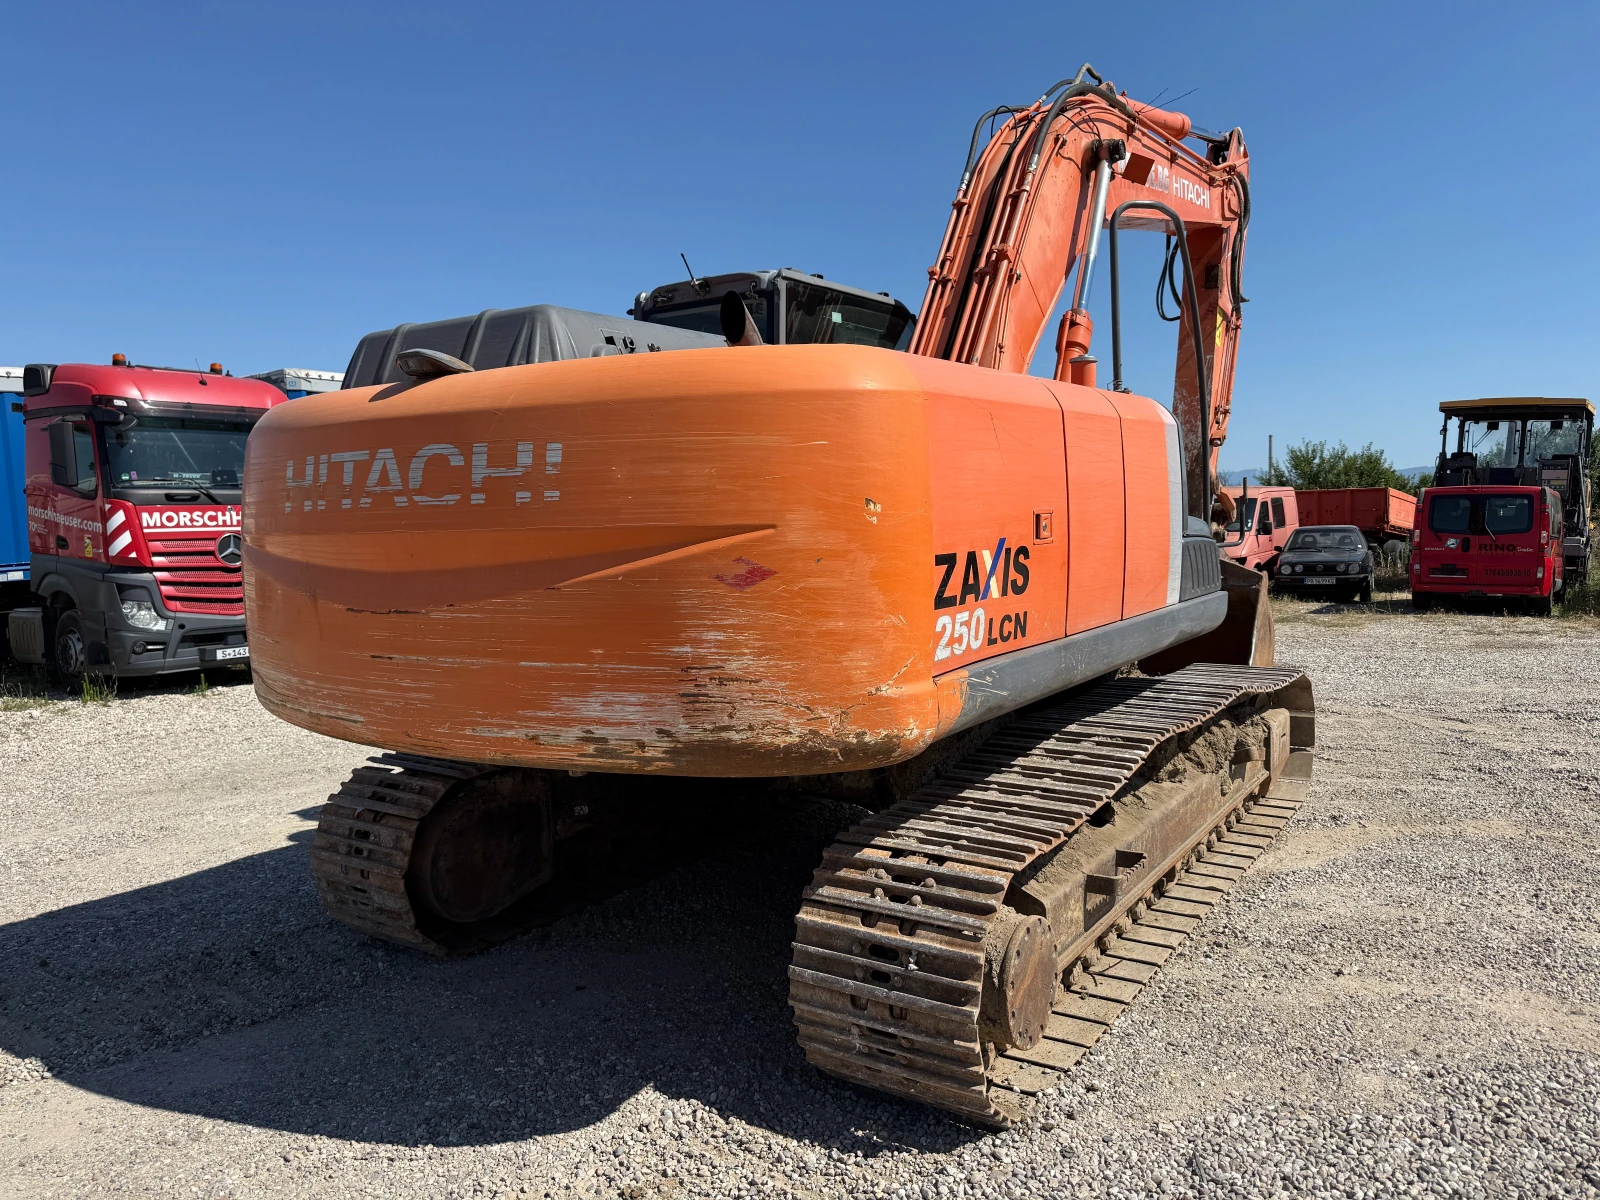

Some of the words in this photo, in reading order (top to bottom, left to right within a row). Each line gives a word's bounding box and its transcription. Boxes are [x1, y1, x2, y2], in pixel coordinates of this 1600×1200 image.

[1173, 175, 1210, 209] HITACHI
[285, 441, 563, 513] HITACHI
[28, 505, 102, 533] morschhaeuser.com
[1479, 543, 1516, 553] RINO
[934, 537, 1030, 610] ZAXIS
[934, 607, 986, 662] 250
[987, 611, 1028, 646] LCN
